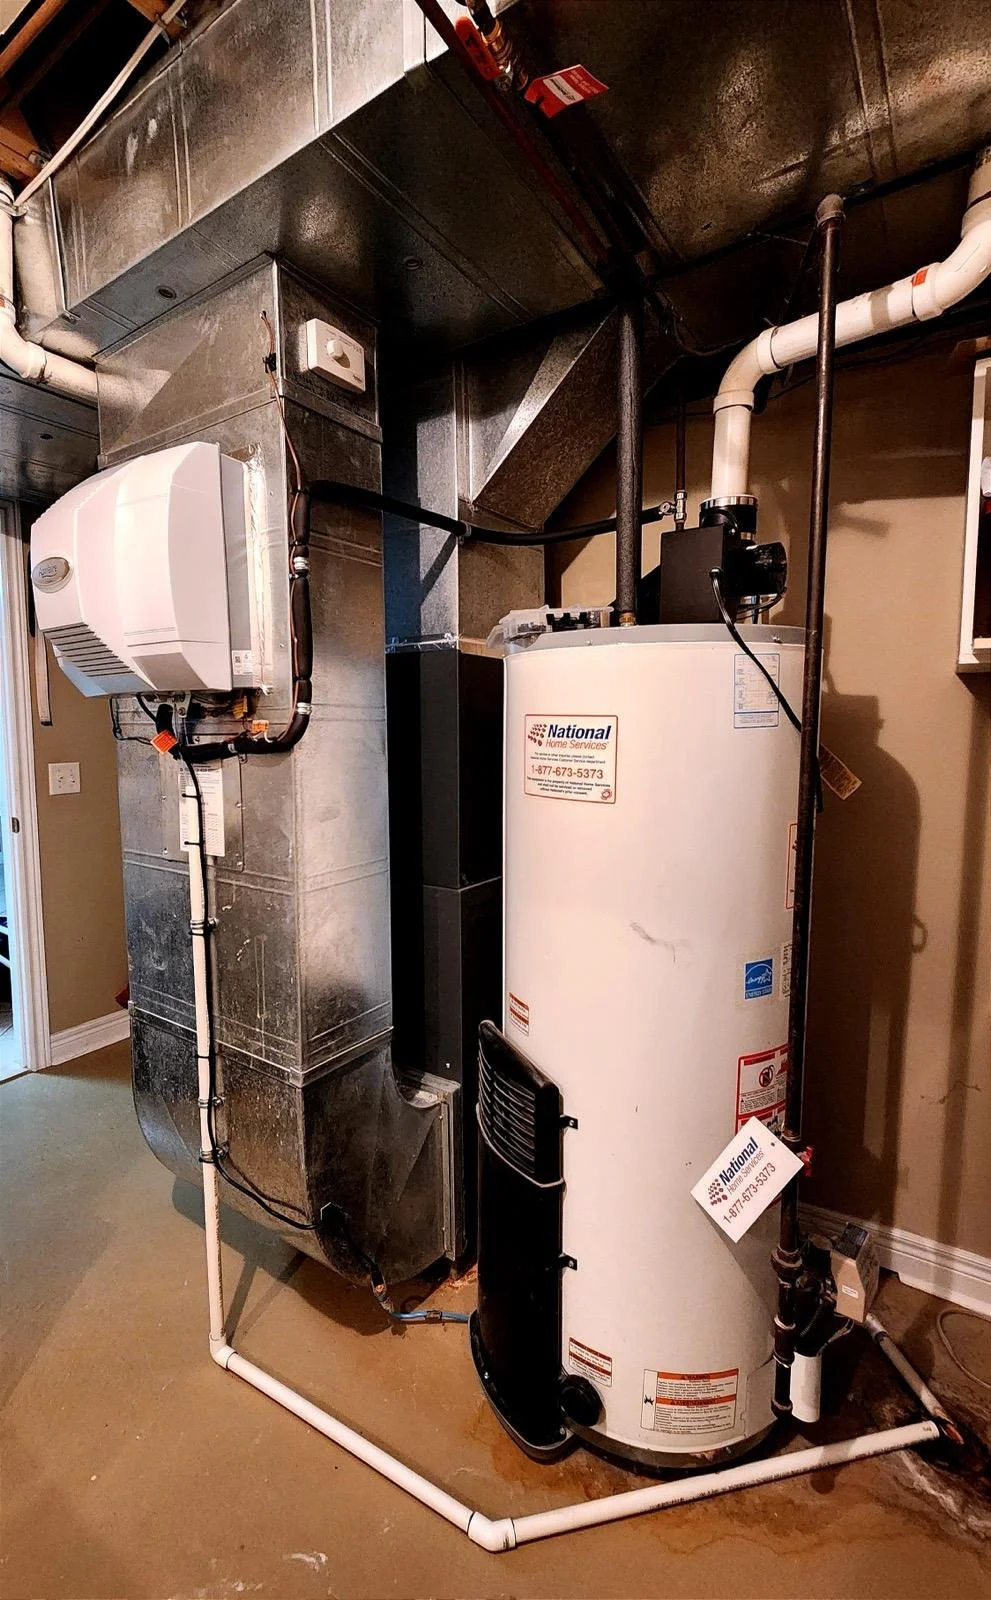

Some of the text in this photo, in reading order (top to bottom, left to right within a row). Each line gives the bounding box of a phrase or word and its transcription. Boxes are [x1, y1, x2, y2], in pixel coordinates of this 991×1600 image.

[546, 739, 607, 750] Home Services
[548, 724, 612, 740] National
[531, 764, 604, 779] 1-877-673-5373
[718, 1136, 758, 1186] National
[726, 1150, 764, 1196] Home Services
[723, 1162, 776, 1224] 1-877-673-5373
